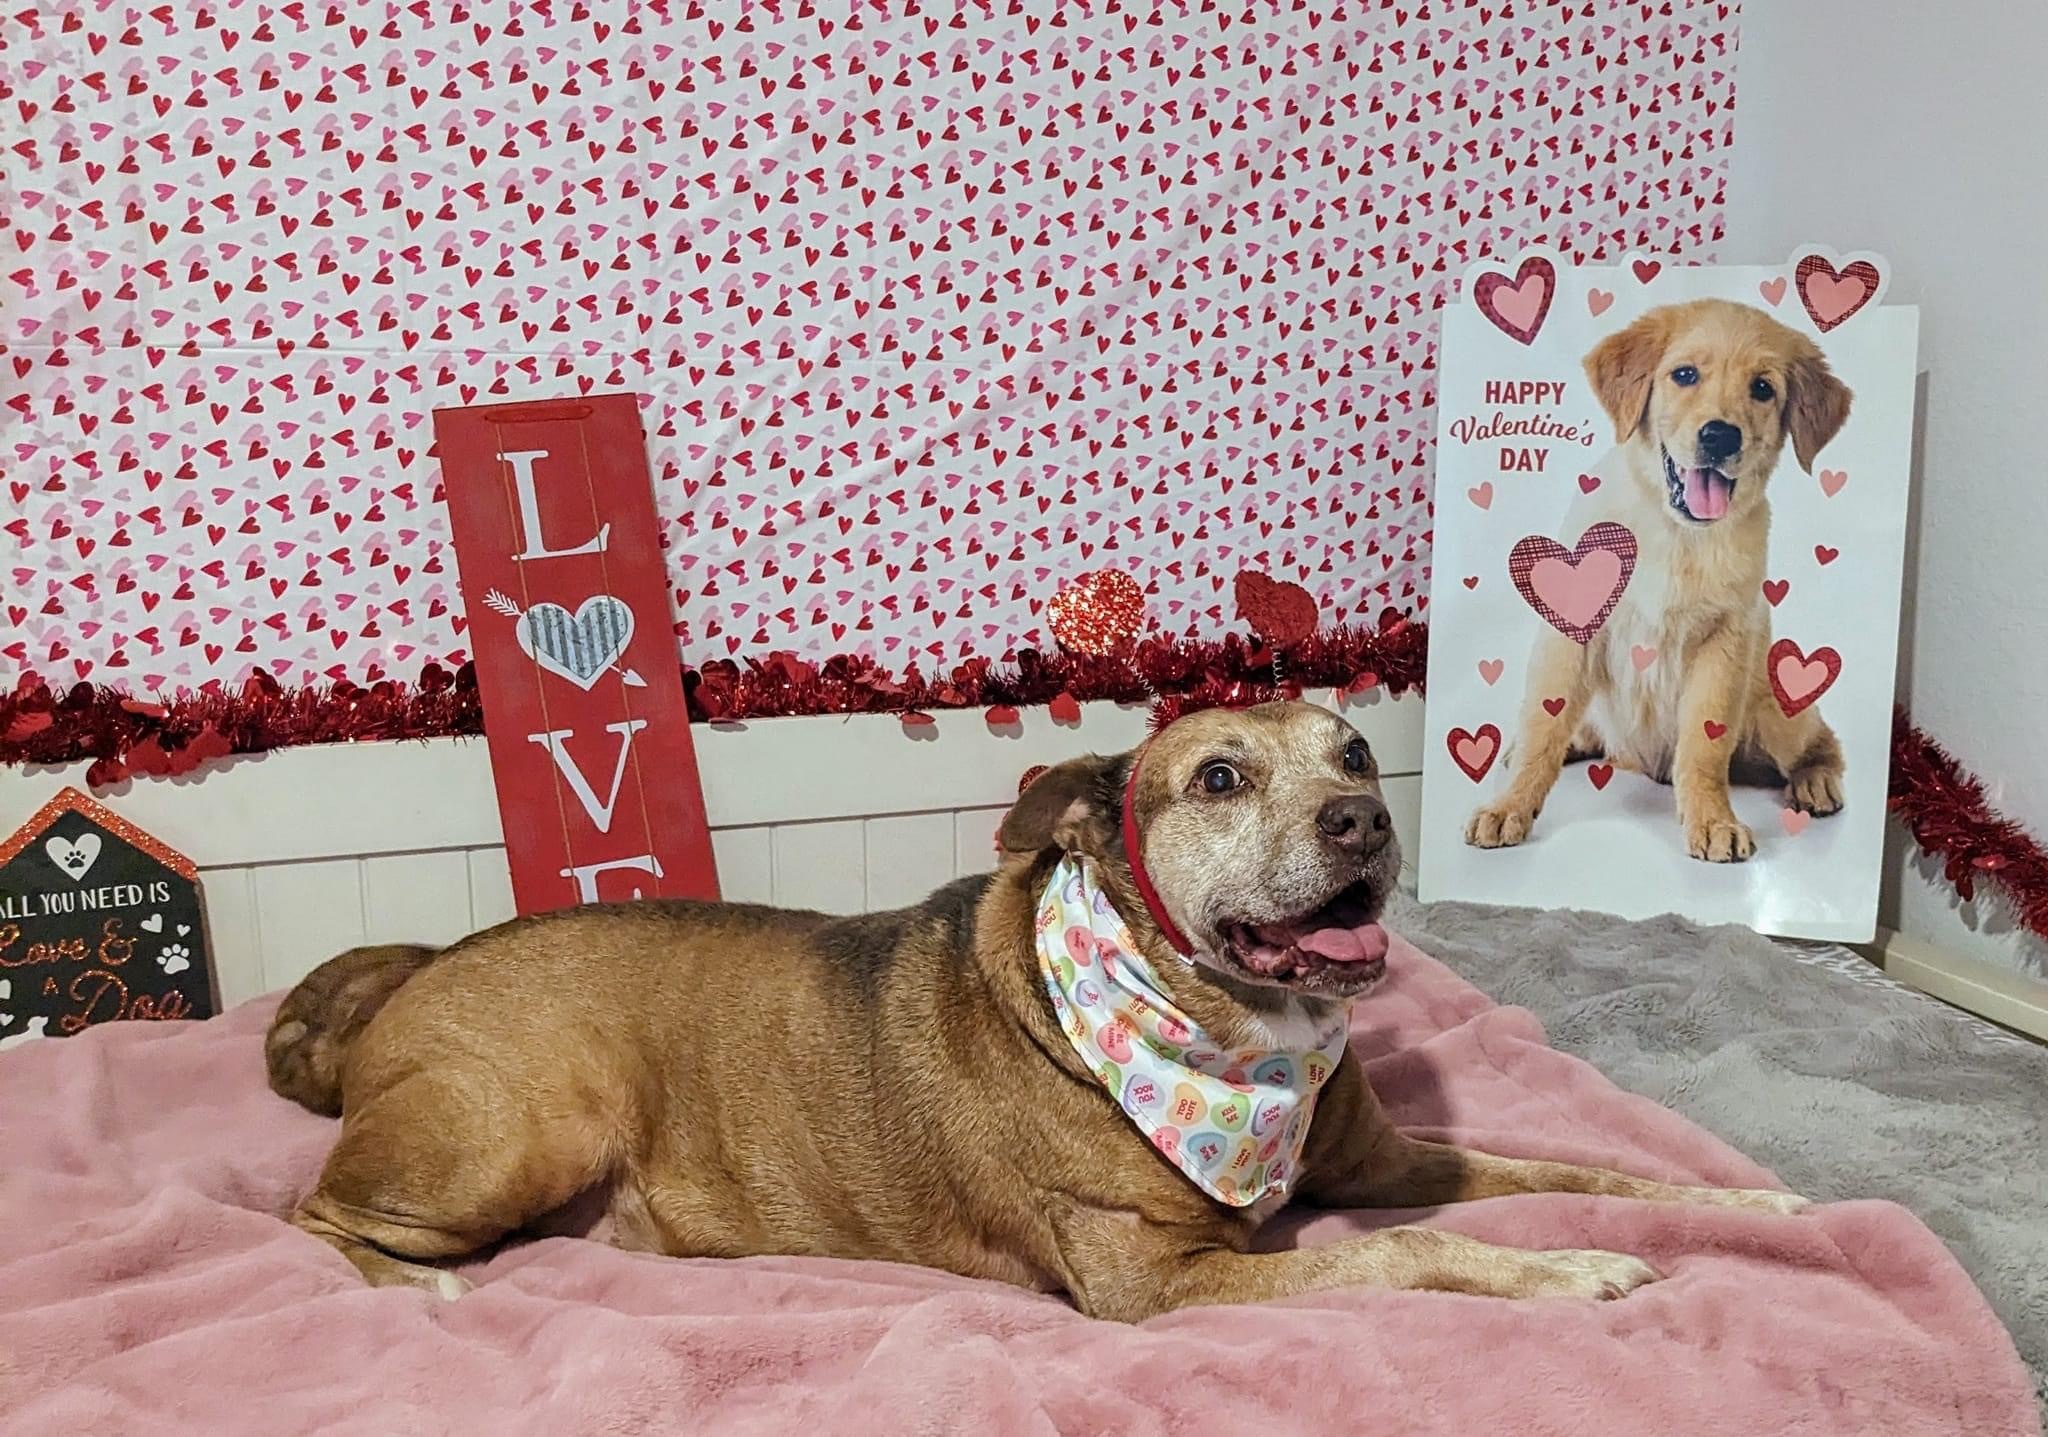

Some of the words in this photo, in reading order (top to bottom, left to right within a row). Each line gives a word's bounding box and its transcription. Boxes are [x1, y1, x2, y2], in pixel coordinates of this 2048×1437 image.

[1485, 380, 1567, 405] HAPPY
[1449, 411, 1595, 446] Valentine's
[1499, 447, 1549, 472] DAY
[40, 892, 74, 914] YOU
[82, 884, 143, 910] NEED
[150, 881, 170, 903] IS
[98, 918, 138, 966] &
[1133, 1083, 1154, 1095] ROCK
[1138, 1094, 1155, 1104] YOU
[1176, 1099, 1188, 1115] TOO
[1185, 1100, 1197, 1120] CUTE
[1221, 1103, 1236, 1117] KISS
[1226, 1113, 1239, 1125] ME
[1262, 1104, 1280, 1118] ROCK
